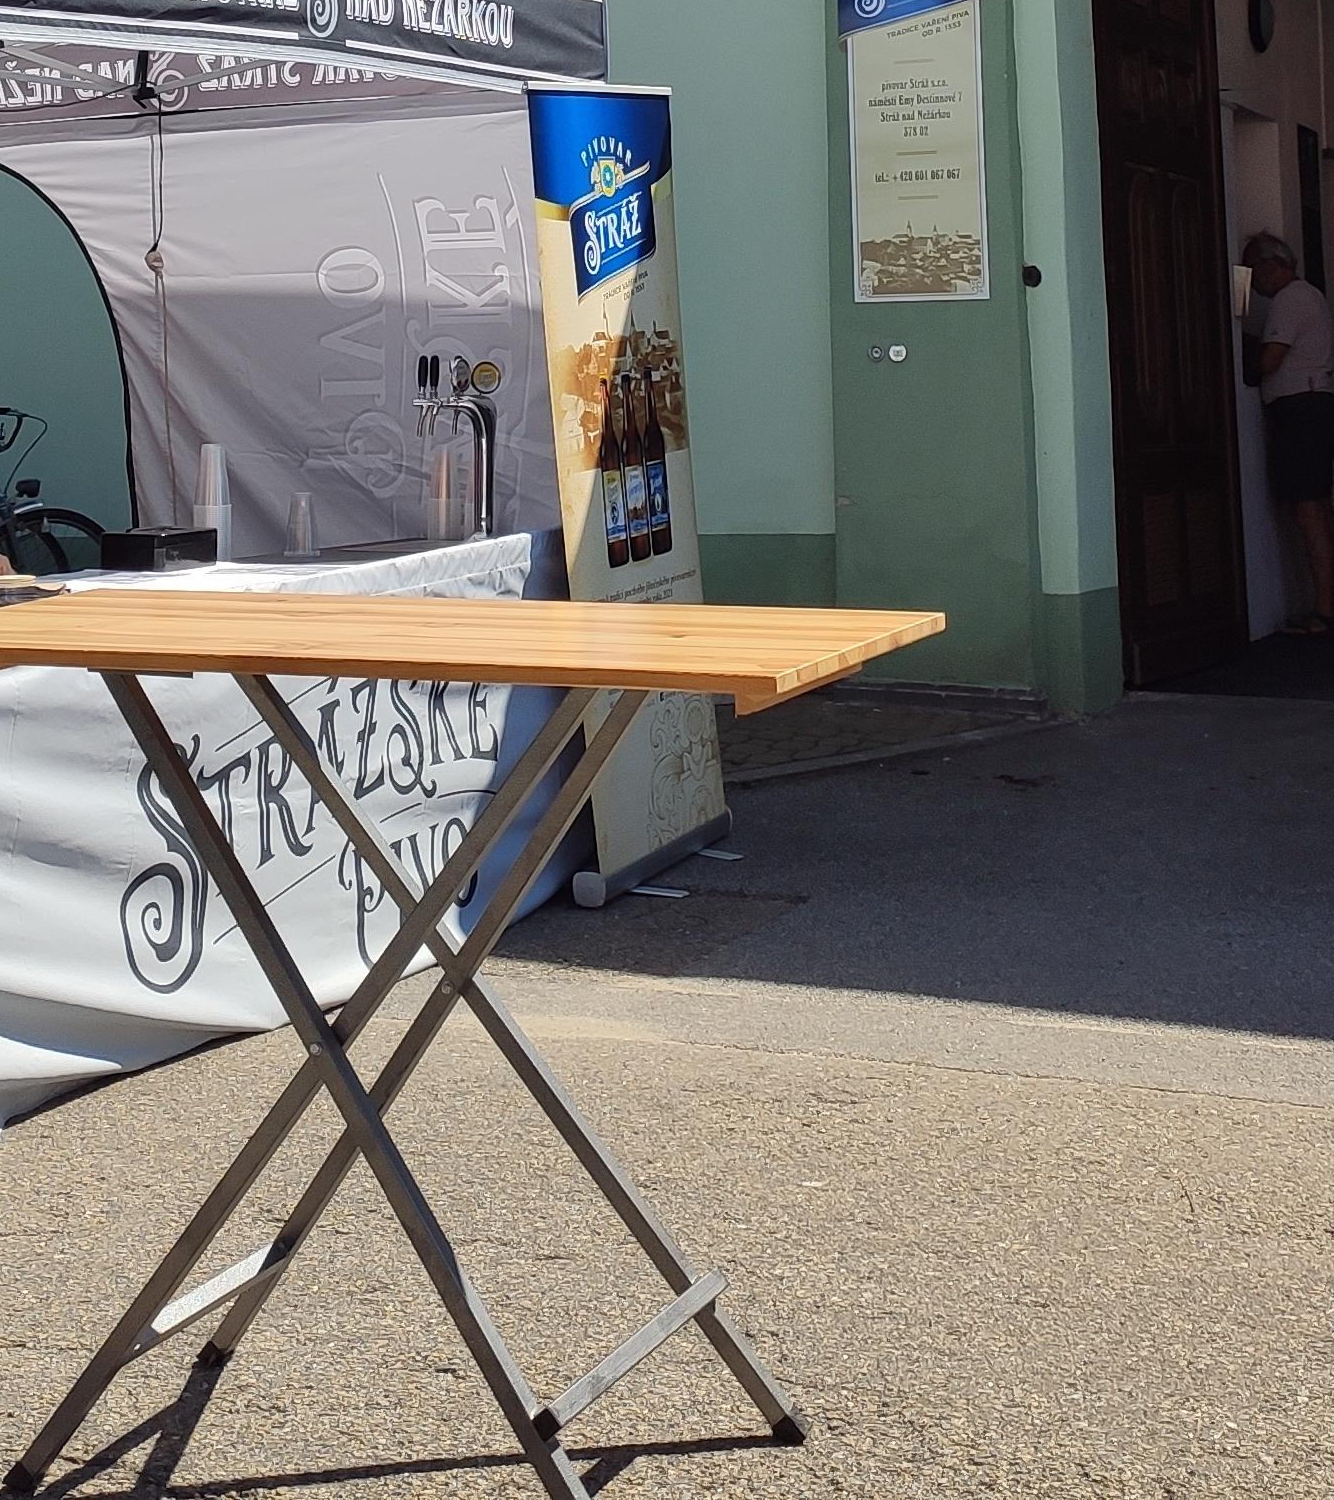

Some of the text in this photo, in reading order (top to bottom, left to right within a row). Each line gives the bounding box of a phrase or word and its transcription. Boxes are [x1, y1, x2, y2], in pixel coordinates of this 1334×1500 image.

[887, 24, 919, 39] TRADICE
[952, 10, 969, 20] PIVA
[922, 29, 934, 37] OD
[899, 95, 914, 107] Emy
[580, 136, 632, 167] PIVOVAR
[584, 194, 642, 275] STRÁŽ
